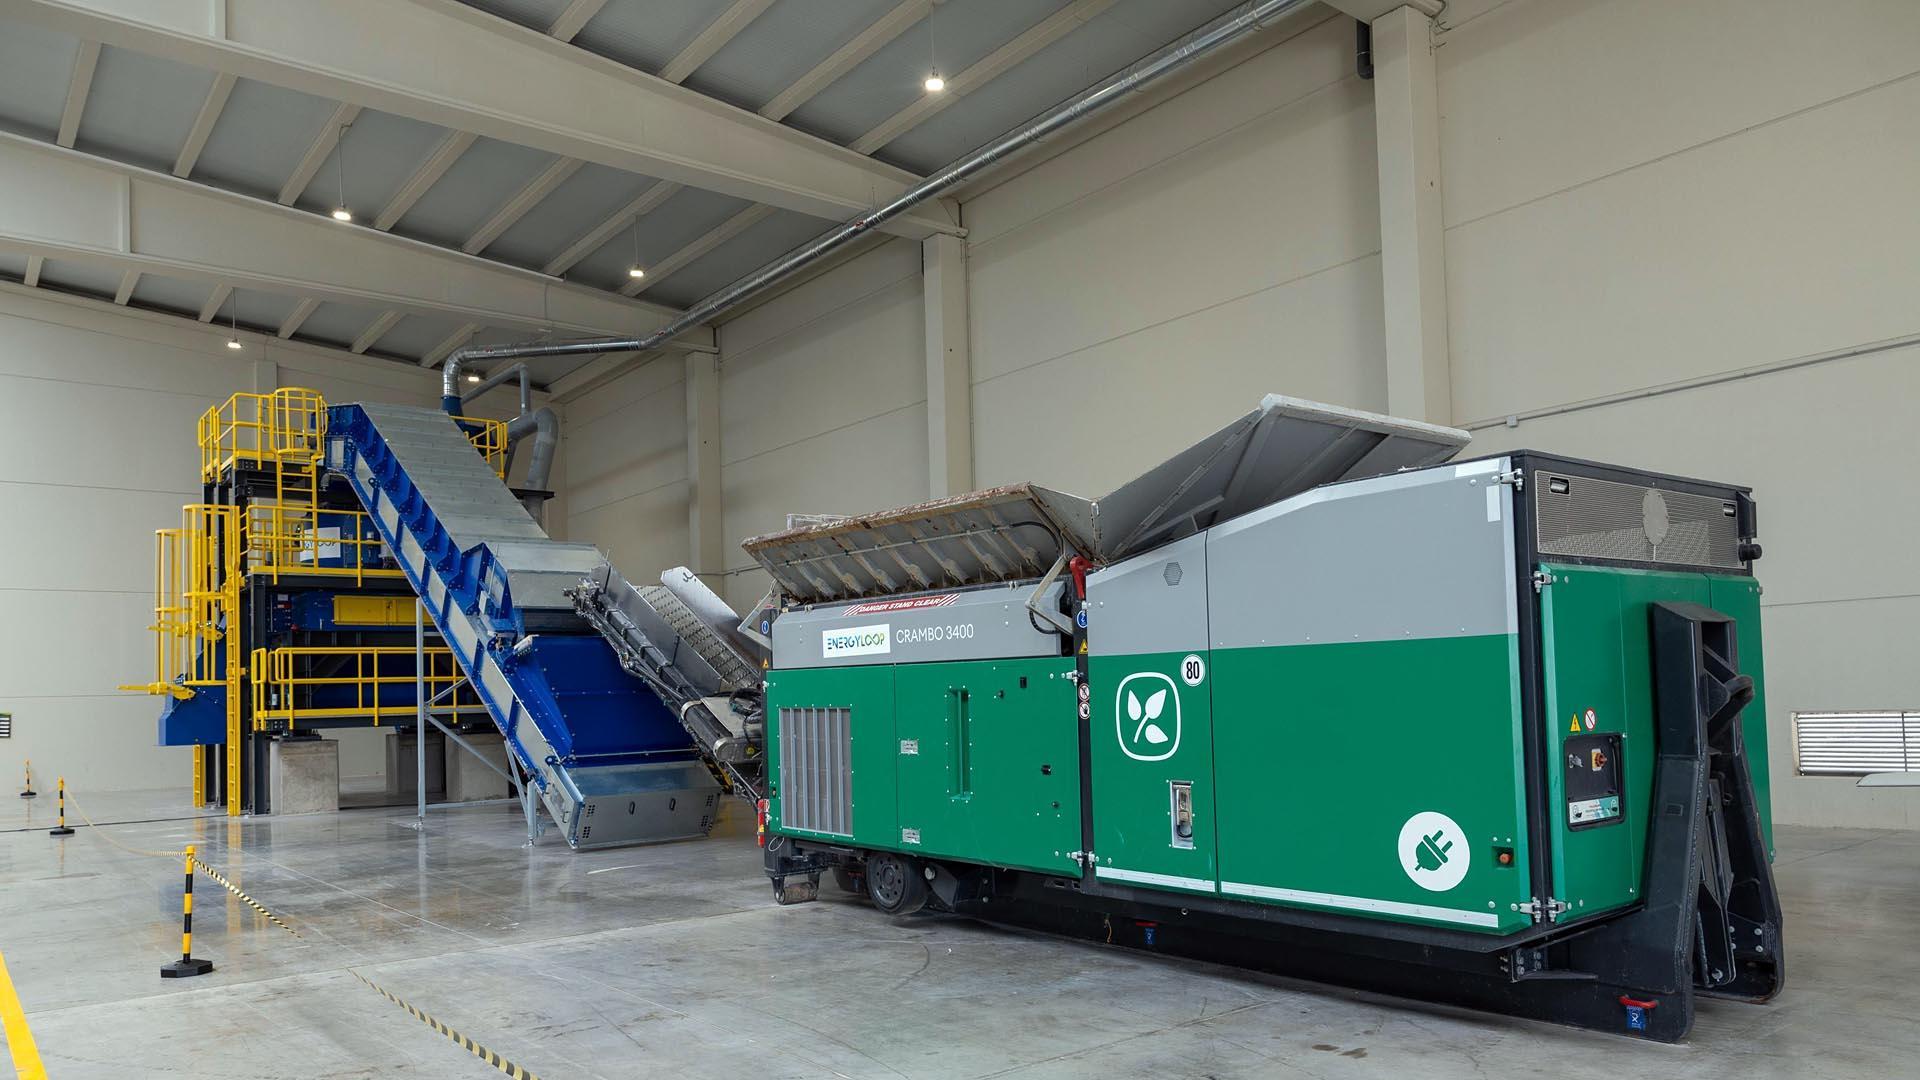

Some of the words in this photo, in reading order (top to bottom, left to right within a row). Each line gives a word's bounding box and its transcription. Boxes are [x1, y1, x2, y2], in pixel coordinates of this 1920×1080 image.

[859, 604, 889, 612] DANGER
[889, 601, 914, 609] STAND
[914, 599, 941, 607] CLEAR
[827, 632, 885, 650] ENERGYLOOP
[896, 626, 944, 643] CRAMBO
[945, 623, 974, 640] 3400
[1186, 661, 1200, 679] 80
